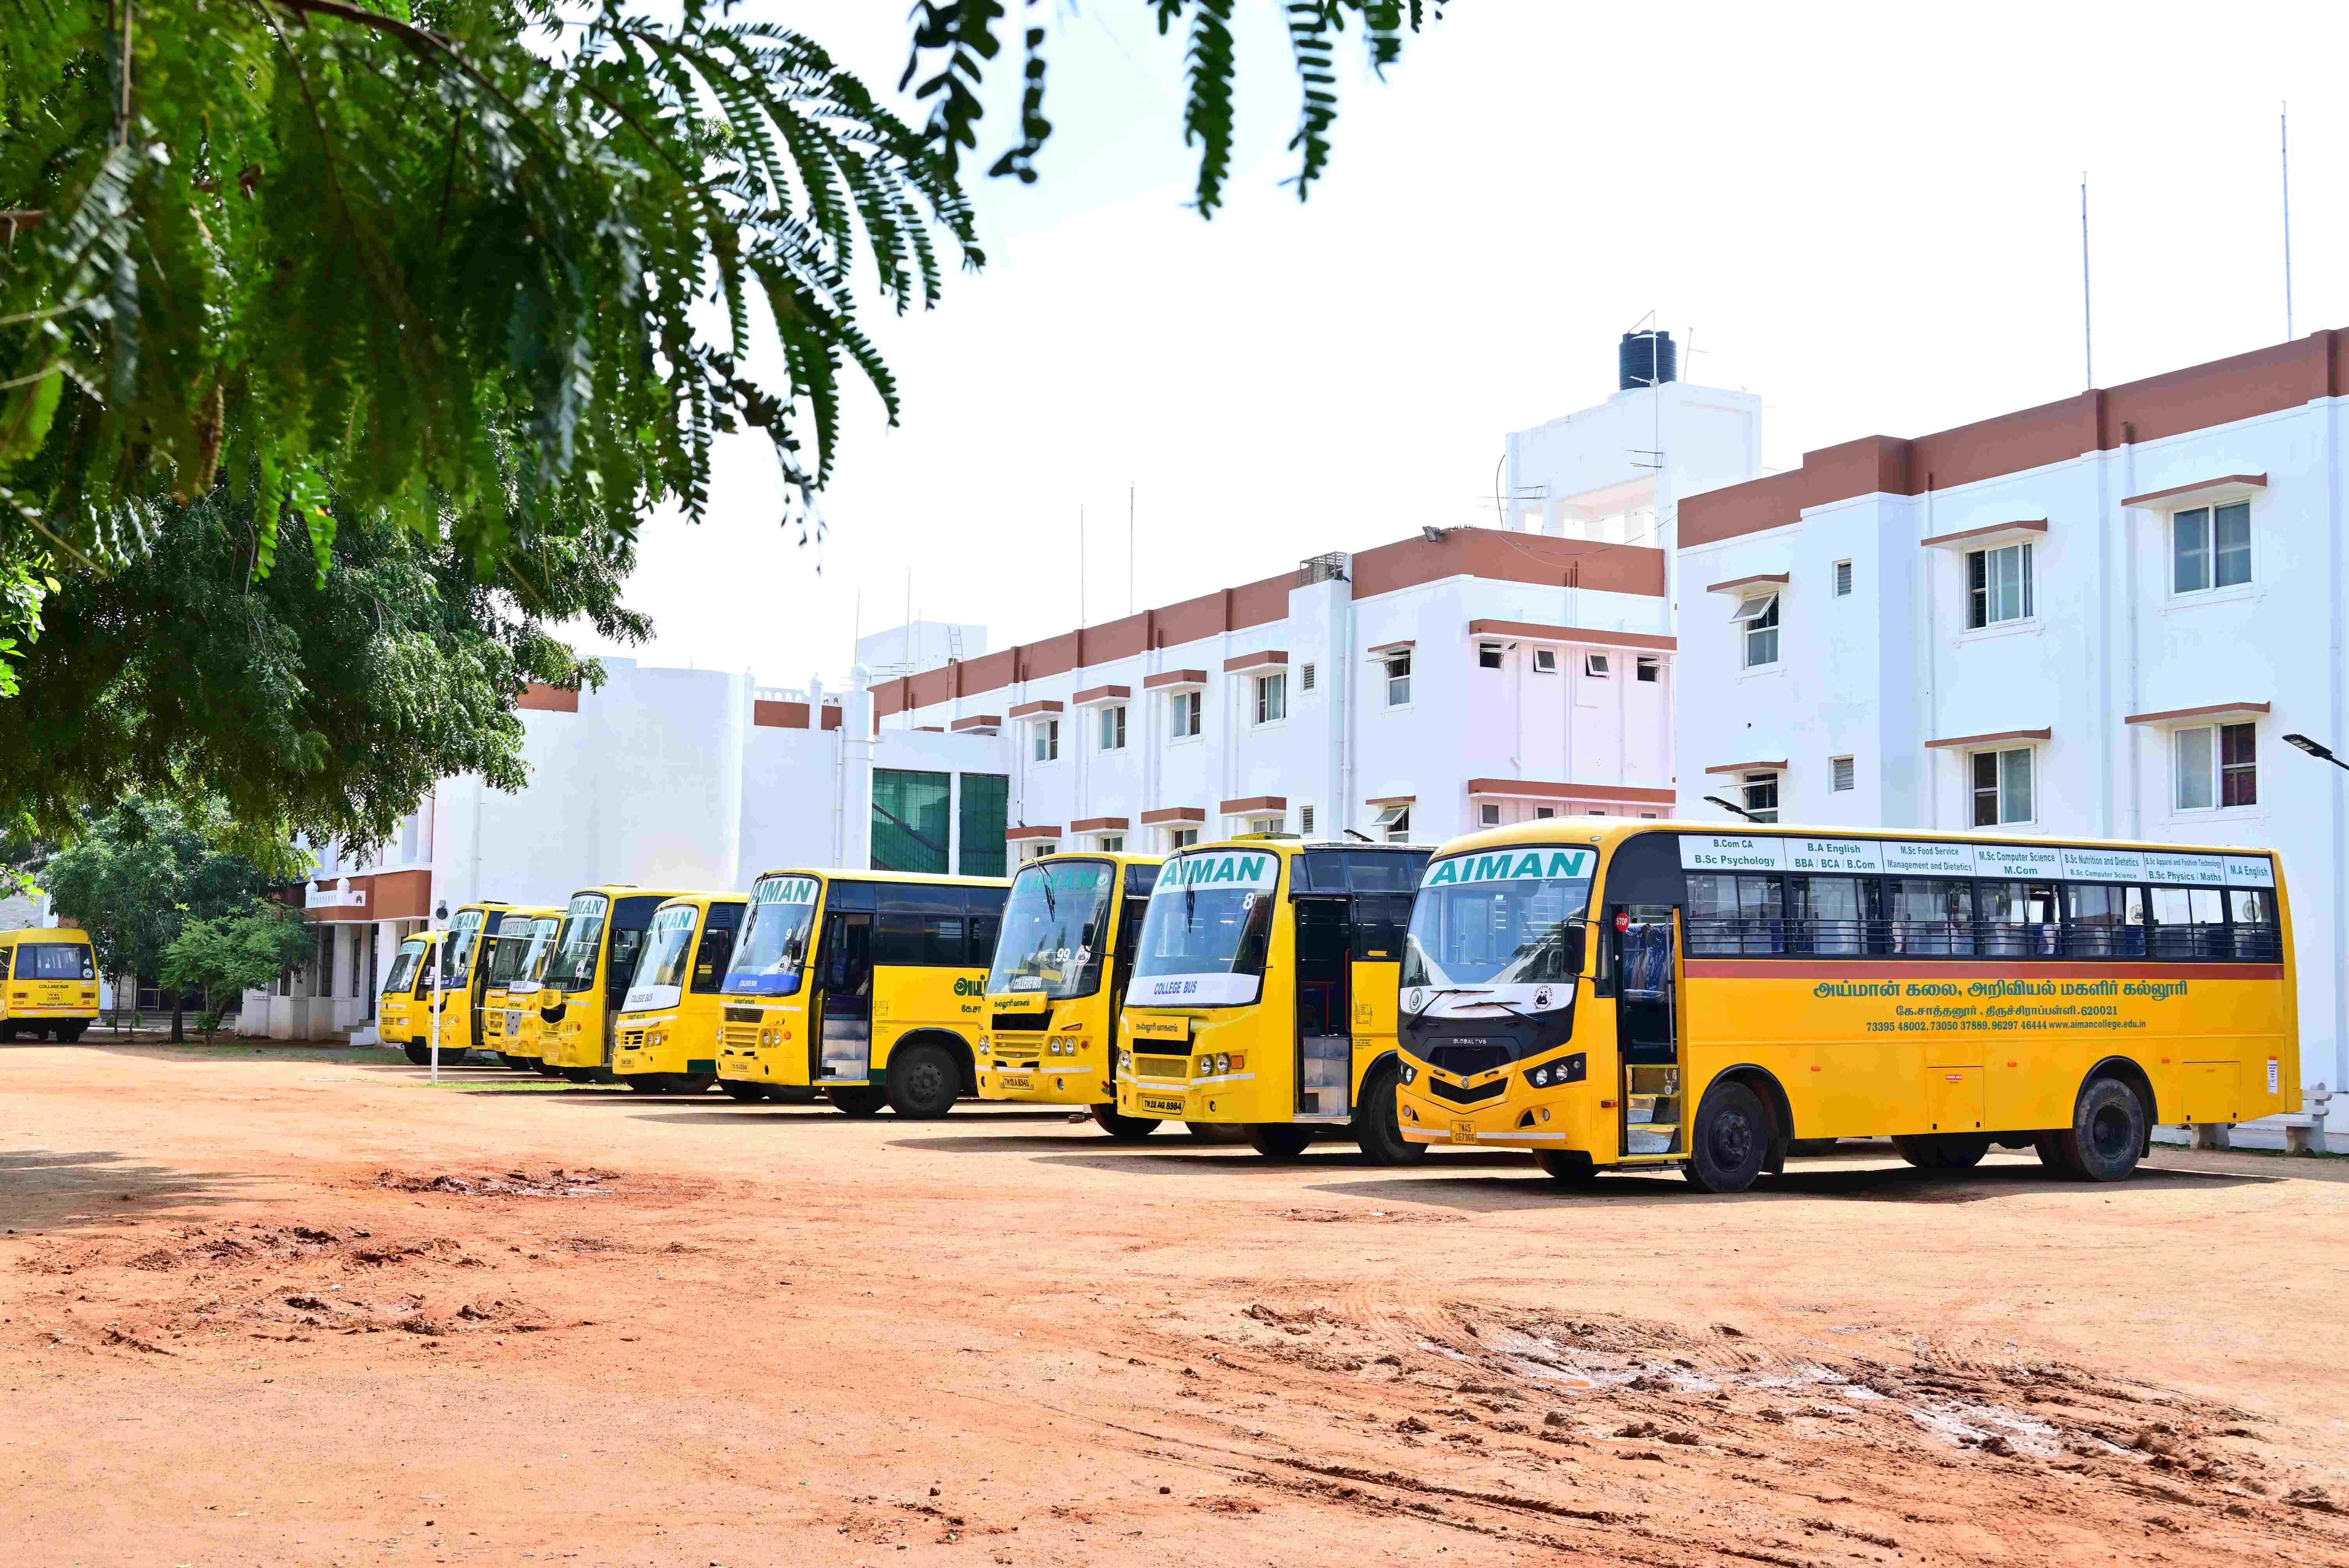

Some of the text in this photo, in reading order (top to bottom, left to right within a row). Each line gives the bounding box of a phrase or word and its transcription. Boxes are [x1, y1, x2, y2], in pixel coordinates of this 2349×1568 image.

[1807, 843, 1860, 854] B.A English
[1900, 846, 1959, 855] M.Sc Food Service
[1695, 855, 1775, 866] B.Sc Psychology
[1979, 851, 2055, 863] M.Sc Computer Science
[2065, 854, 2139, 866] B.Sc Nutrition and Dietetics
[1428, 853, 1585, 885] AIMAN
[1795, 859, 1814, 868] BBA
[1821, 859, 1840, 868] BCA
[1847, 860, 1875, 869] B.Com
[1887, 859, 1972, 871] Management and Dietetics
[2004, 866, 2037, 874] M.Com
[1159, 857, 1266, 887] AIMAN
[2149, 871, 2165, 879] B.Sc
[2167, 871, 2195, 882] Physics
[2200, 872, 2221, 881] Maths
[2230, 865, 2268, 878] M.A English
[749, 881, 813, 904] AIMAN
[1243, 892, 1255, 910] 8
[785, 928, 792, 940] 9
[1056, 948, 1071, 962] 99
[1154, 980, 1197, 995] COLLEGE BUS
[1813, 980, 1901, 998] அய்மான்
[1967, 979, 2056, 1000] அறிவியல்
[2061, 980, 2119, 996] மகளிர்
[2123, 980, 2188, 1001] கல்லூரி
[1866, 1022, 1895, 1032] 73395
[1930, 1021, 1958, 1031] 73050
[1992, 1021, 2018, 1030] 96297
[2020, 1021, 2047, 1030] 46444
[2049, 1019, 2146, 1030] www.aimancollege.edu.in
[1458, 1124, 1471, 1132] TN45
